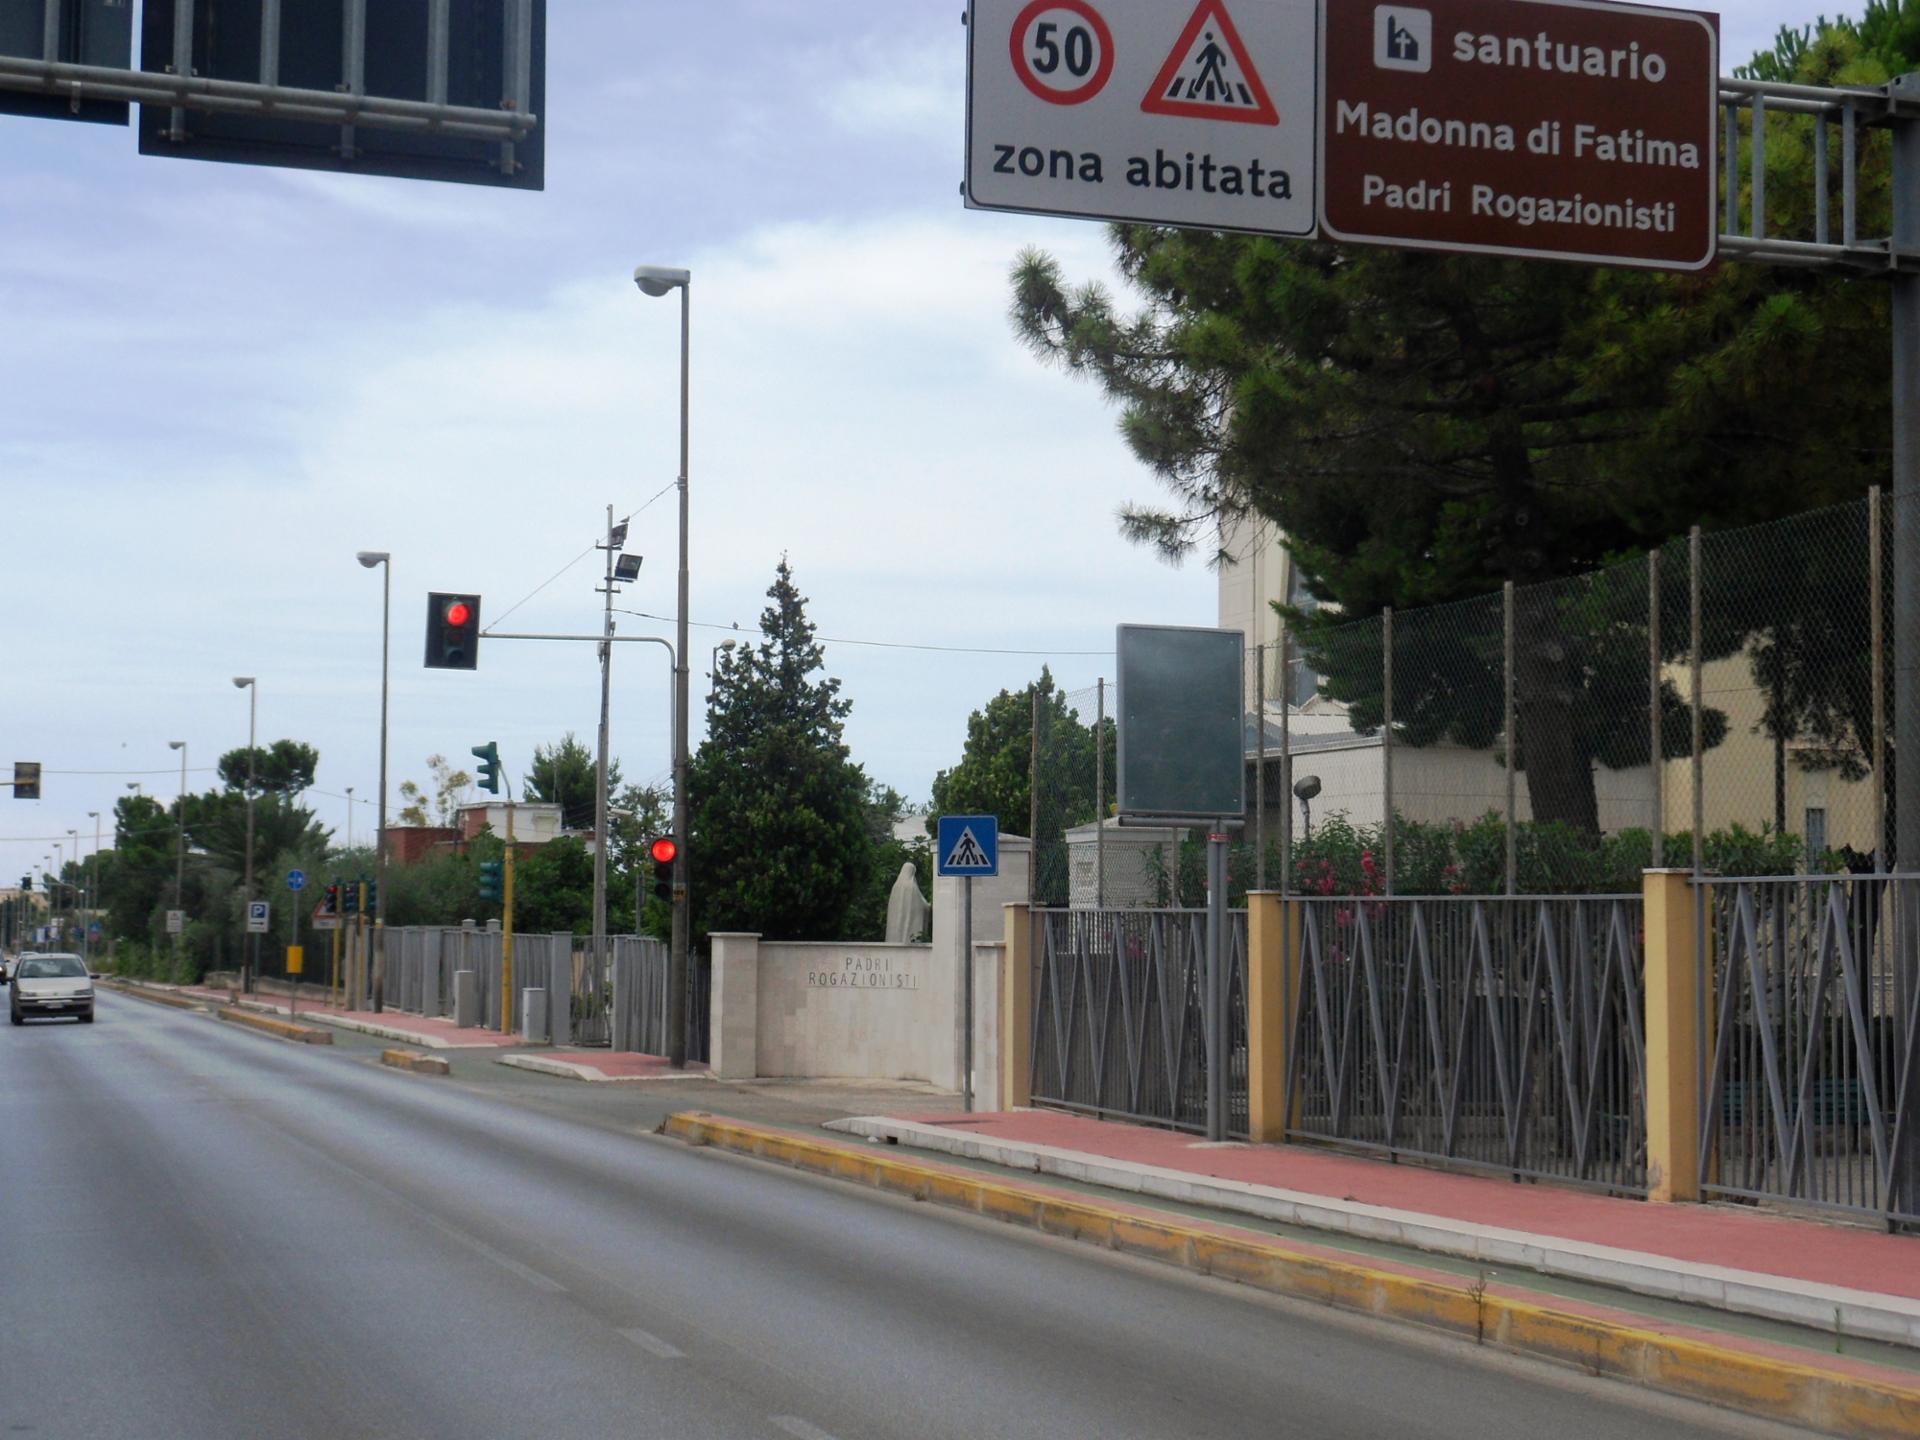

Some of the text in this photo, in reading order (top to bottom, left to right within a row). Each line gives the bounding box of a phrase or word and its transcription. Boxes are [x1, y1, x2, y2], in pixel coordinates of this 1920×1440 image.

[1032, 22, 1093, 77] 50
[1452, 31, 1667, 83] santuario
[1335, 99, 1699, 169] Madonna di Fatima
[993, 143, 1292, 200] zona abitata
[1363, 174, 1675, 232] Padri Rogazionisti
[808, 972, 916, 988] ROGAZIONISTI
[845, 957, 889, 972] PADRI
